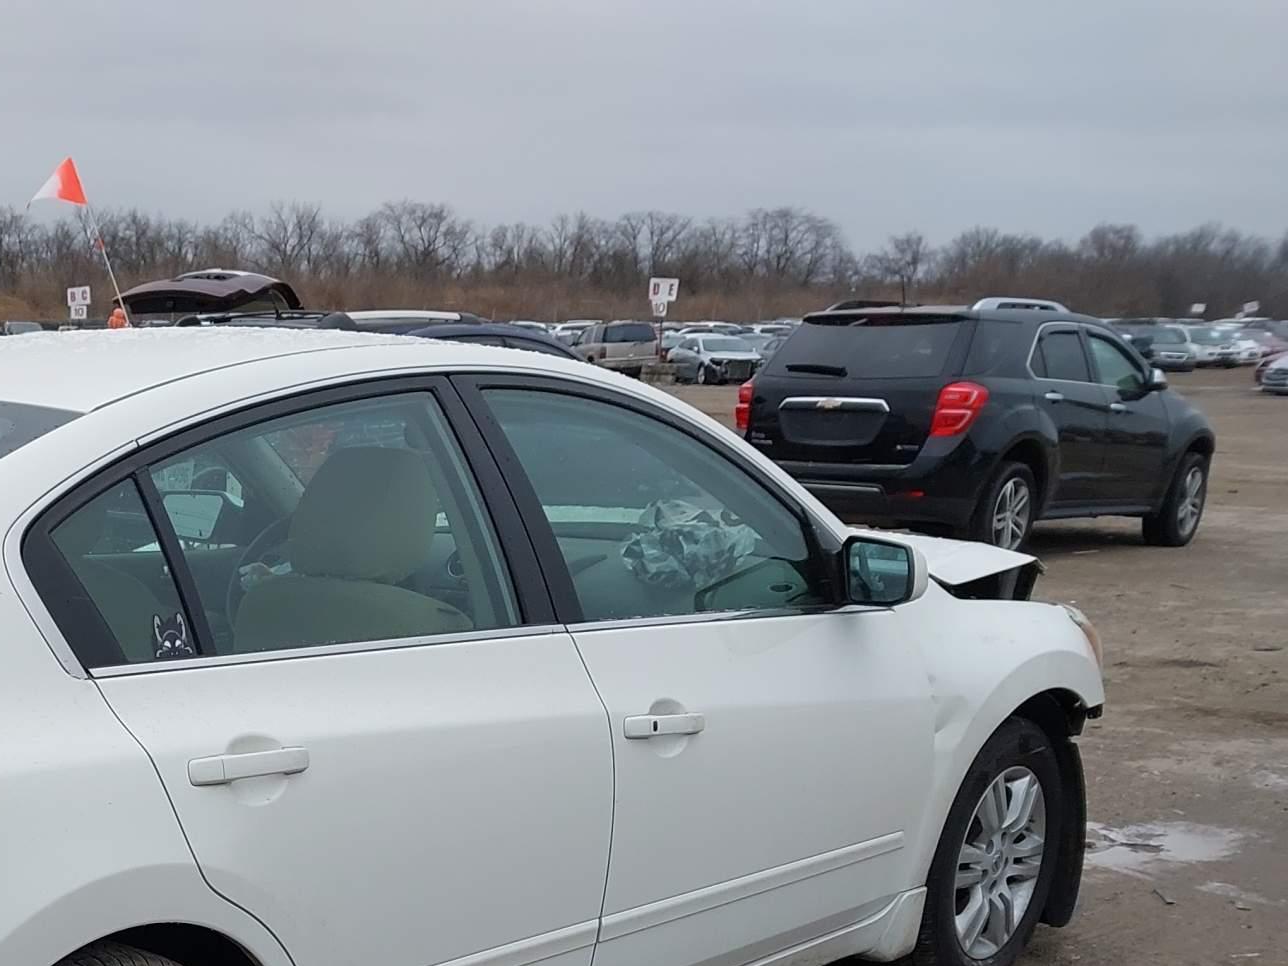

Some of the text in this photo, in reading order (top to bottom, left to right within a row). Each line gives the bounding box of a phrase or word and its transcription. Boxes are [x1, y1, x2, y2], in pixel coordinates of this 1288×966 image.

[70, 289, 88, 303] B C
[668, 282, 675, 297] E
